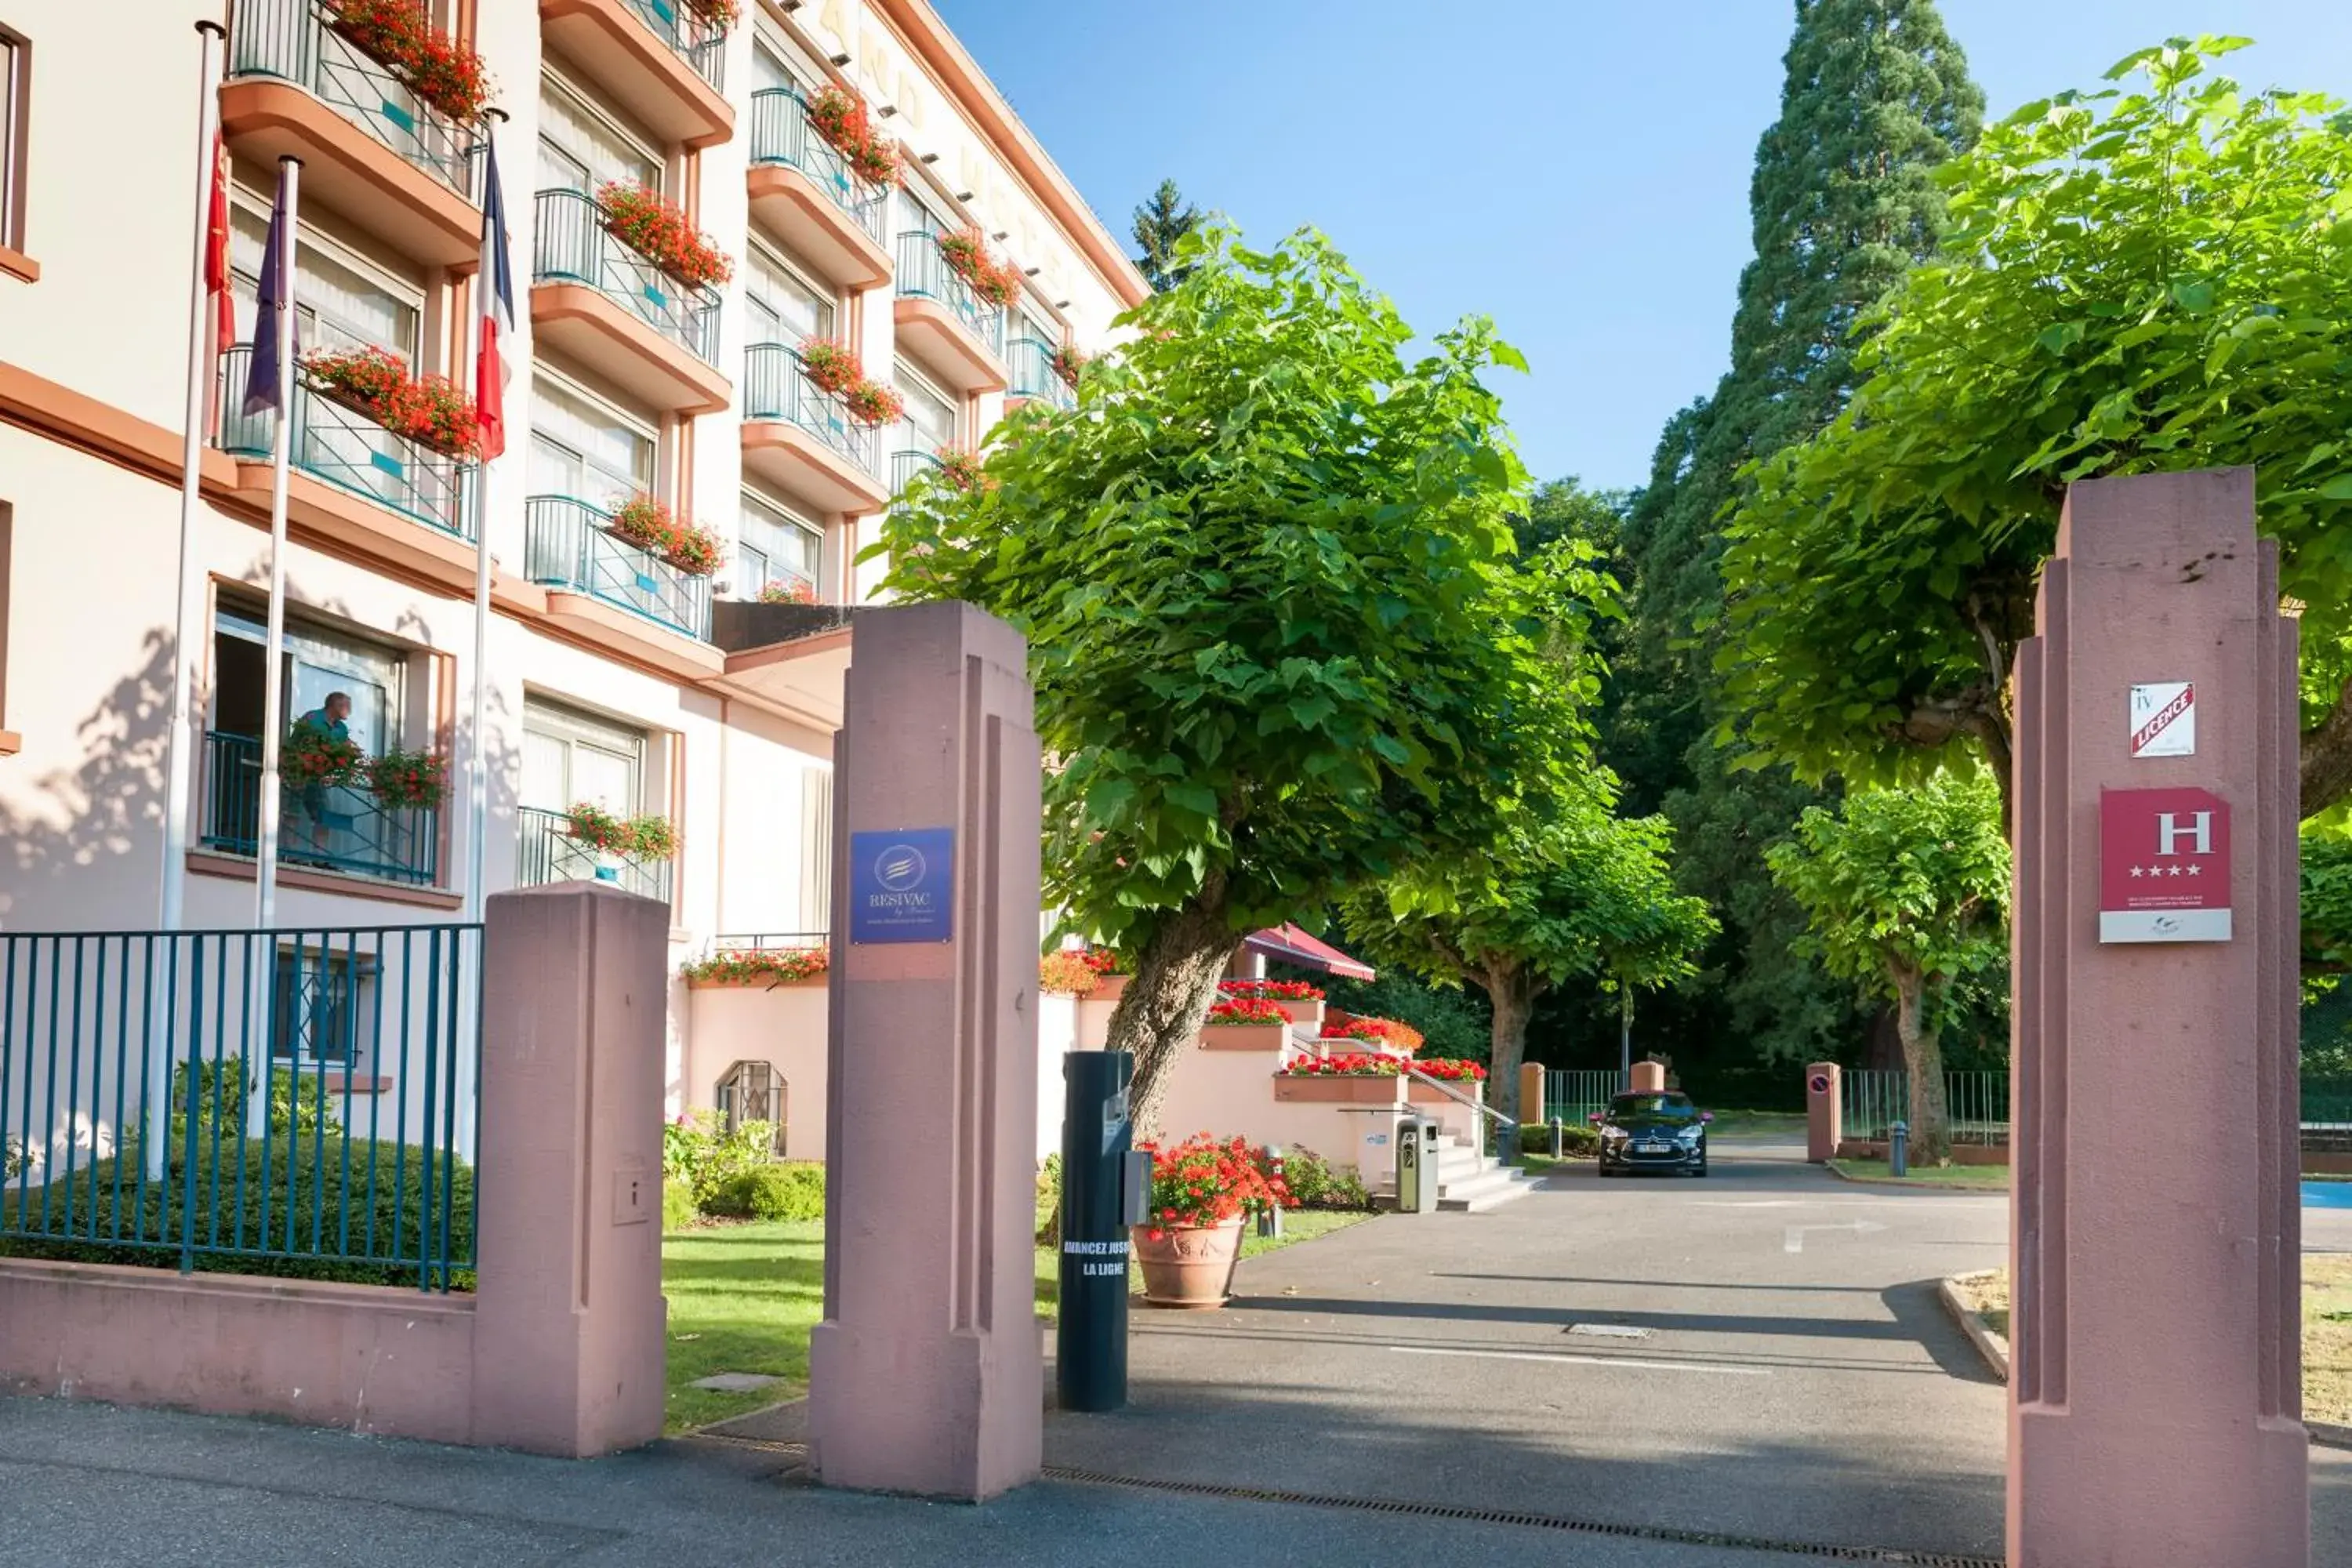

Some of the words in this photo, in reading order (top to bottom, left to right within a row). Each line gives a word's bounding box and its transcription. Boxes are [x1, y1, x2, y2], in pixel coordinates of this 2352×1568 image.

[2138, 691, 2188, 747] LICENCE
[2154, 811, 2216, 855] H
[870, 893, 929, 906] RESIVAC
[1083, 1263, 1097, 1276] LA
[1098, 1263, 1123, 1276] LIGNE
